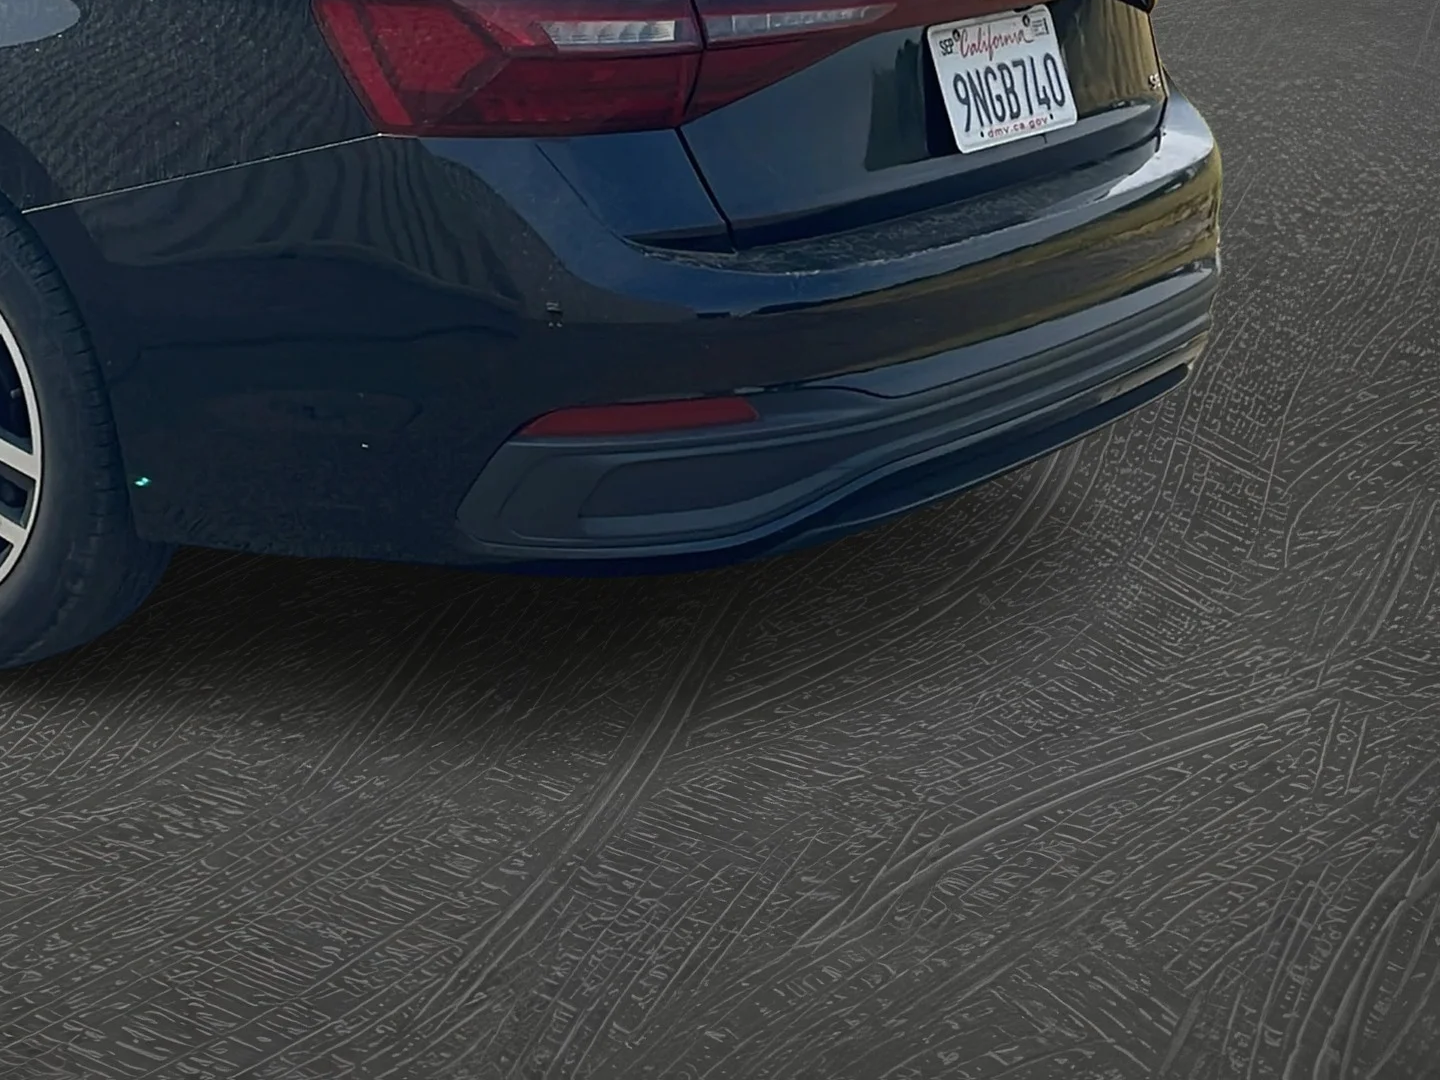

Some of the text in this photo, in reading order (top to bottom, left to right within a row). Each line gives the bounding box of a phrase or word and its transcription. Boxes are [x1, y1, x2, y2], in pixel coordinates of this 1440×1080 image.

[939, 37, 954, 56] SEP
[959, 25, 1034, 61] California
[953, 52, 1066, 132] 9NGB740
